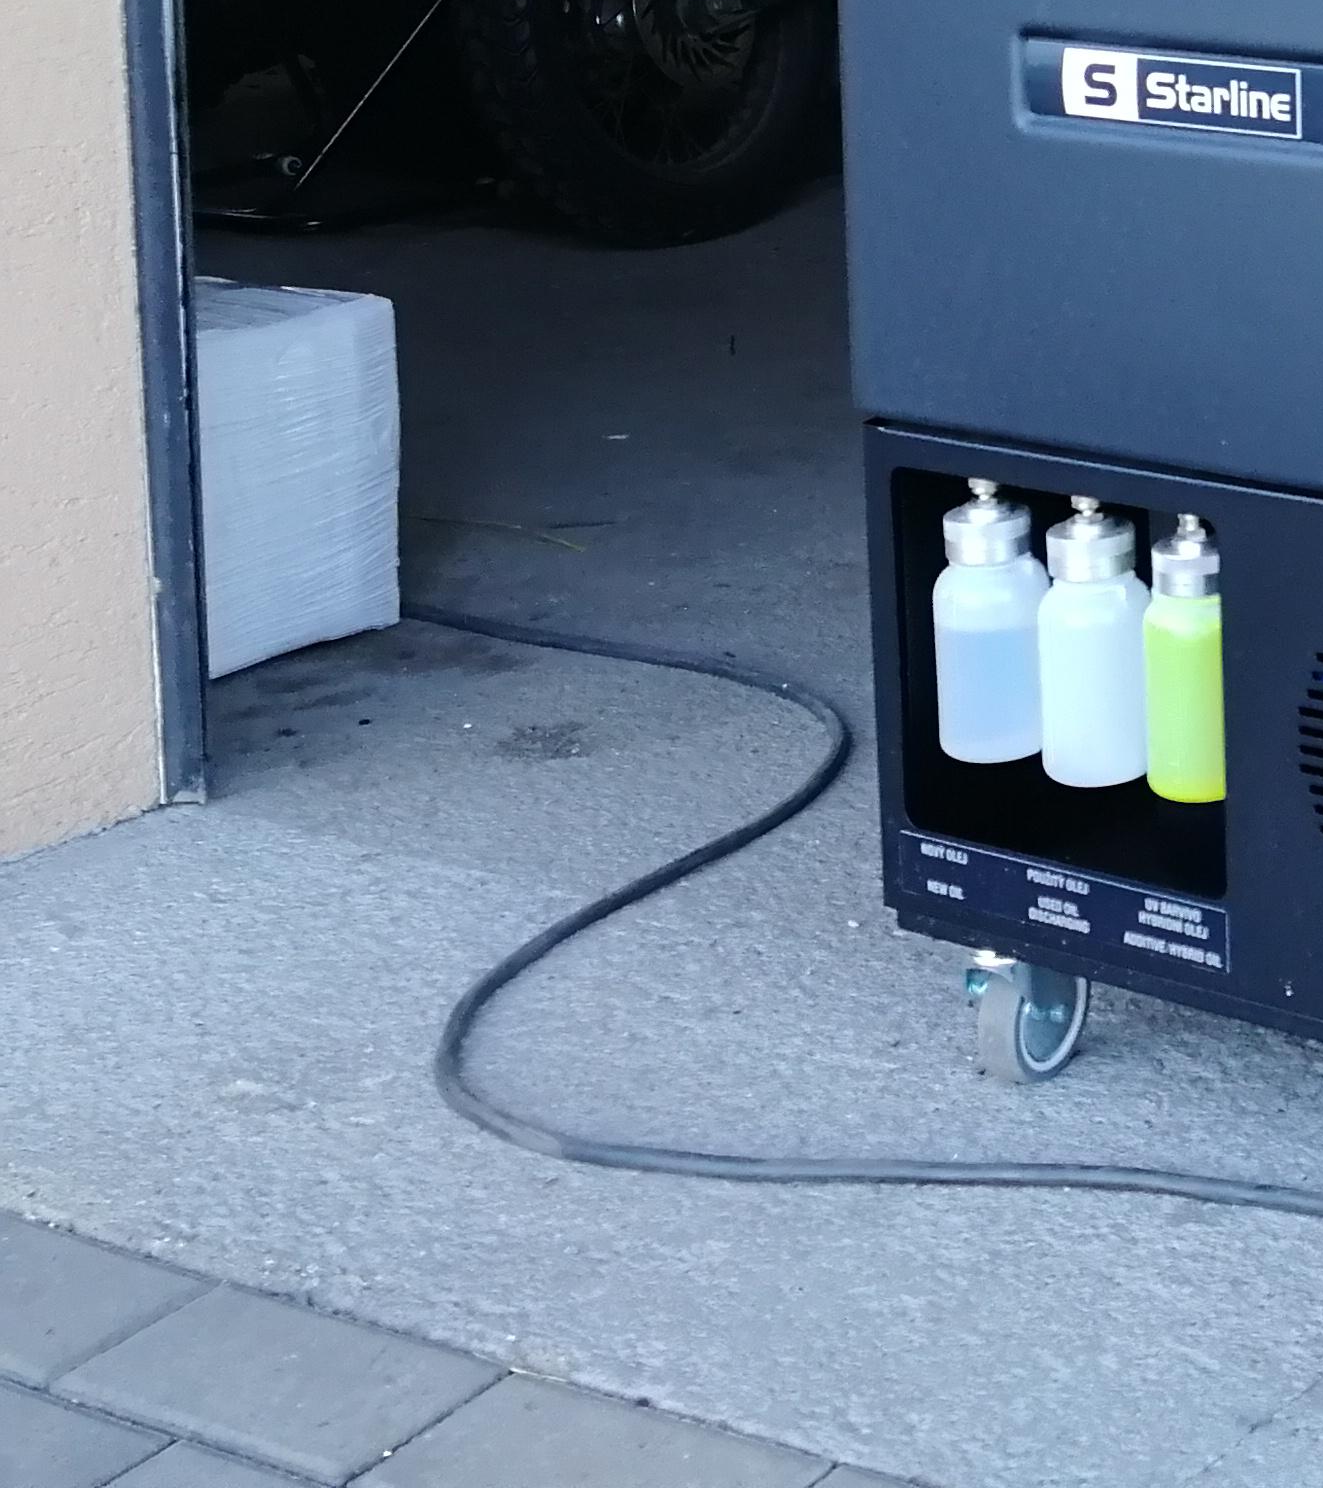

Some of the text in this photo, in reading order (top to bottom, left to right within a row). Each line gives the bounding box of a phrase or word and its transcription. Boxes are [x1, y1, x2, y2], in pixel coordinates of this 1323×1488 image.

[1084, 63, 1292, 123] S Starline
[926, 879, 948, 896] NEW
